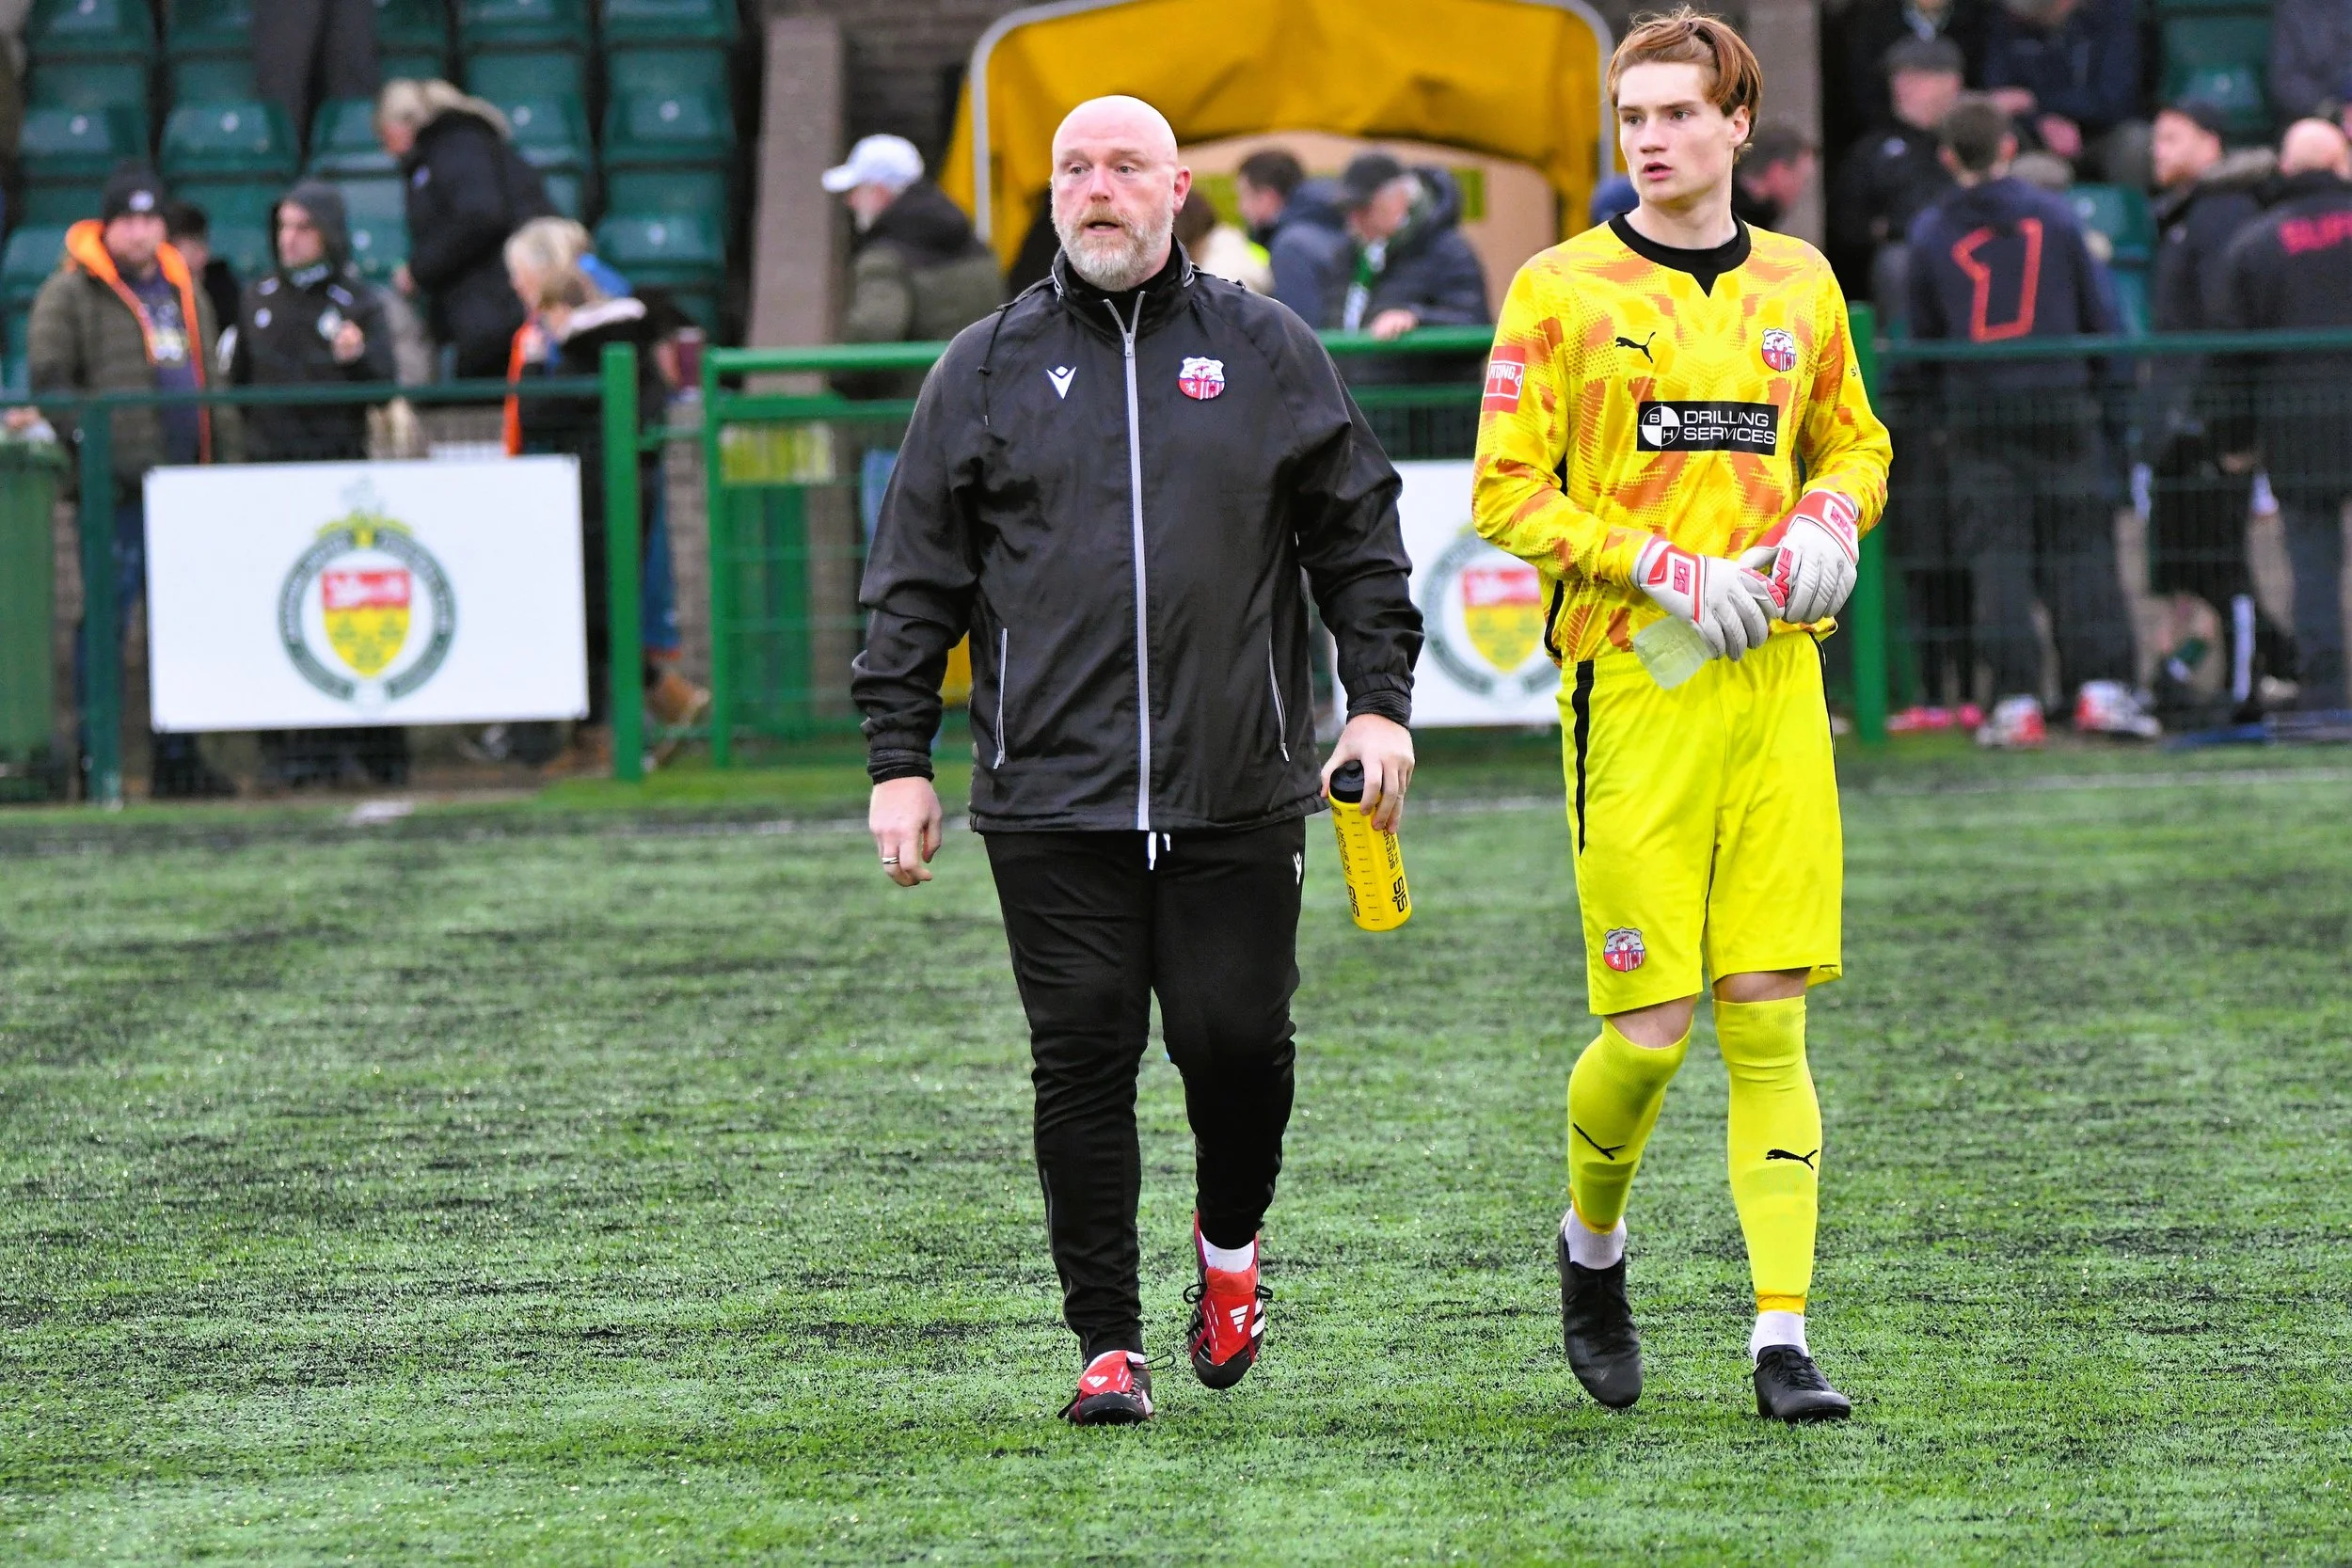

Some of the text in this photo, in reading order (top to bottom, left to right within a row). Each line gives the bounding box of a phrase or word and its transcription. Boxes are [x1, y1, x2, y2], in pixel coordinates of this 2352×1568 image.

[1649, 414, 1661, 423] B
[1683, 410, 1770, 427] DRILLING
[1662, 429, 1674, 439] H
[1683, 427, 1776, 445] SERVICES
